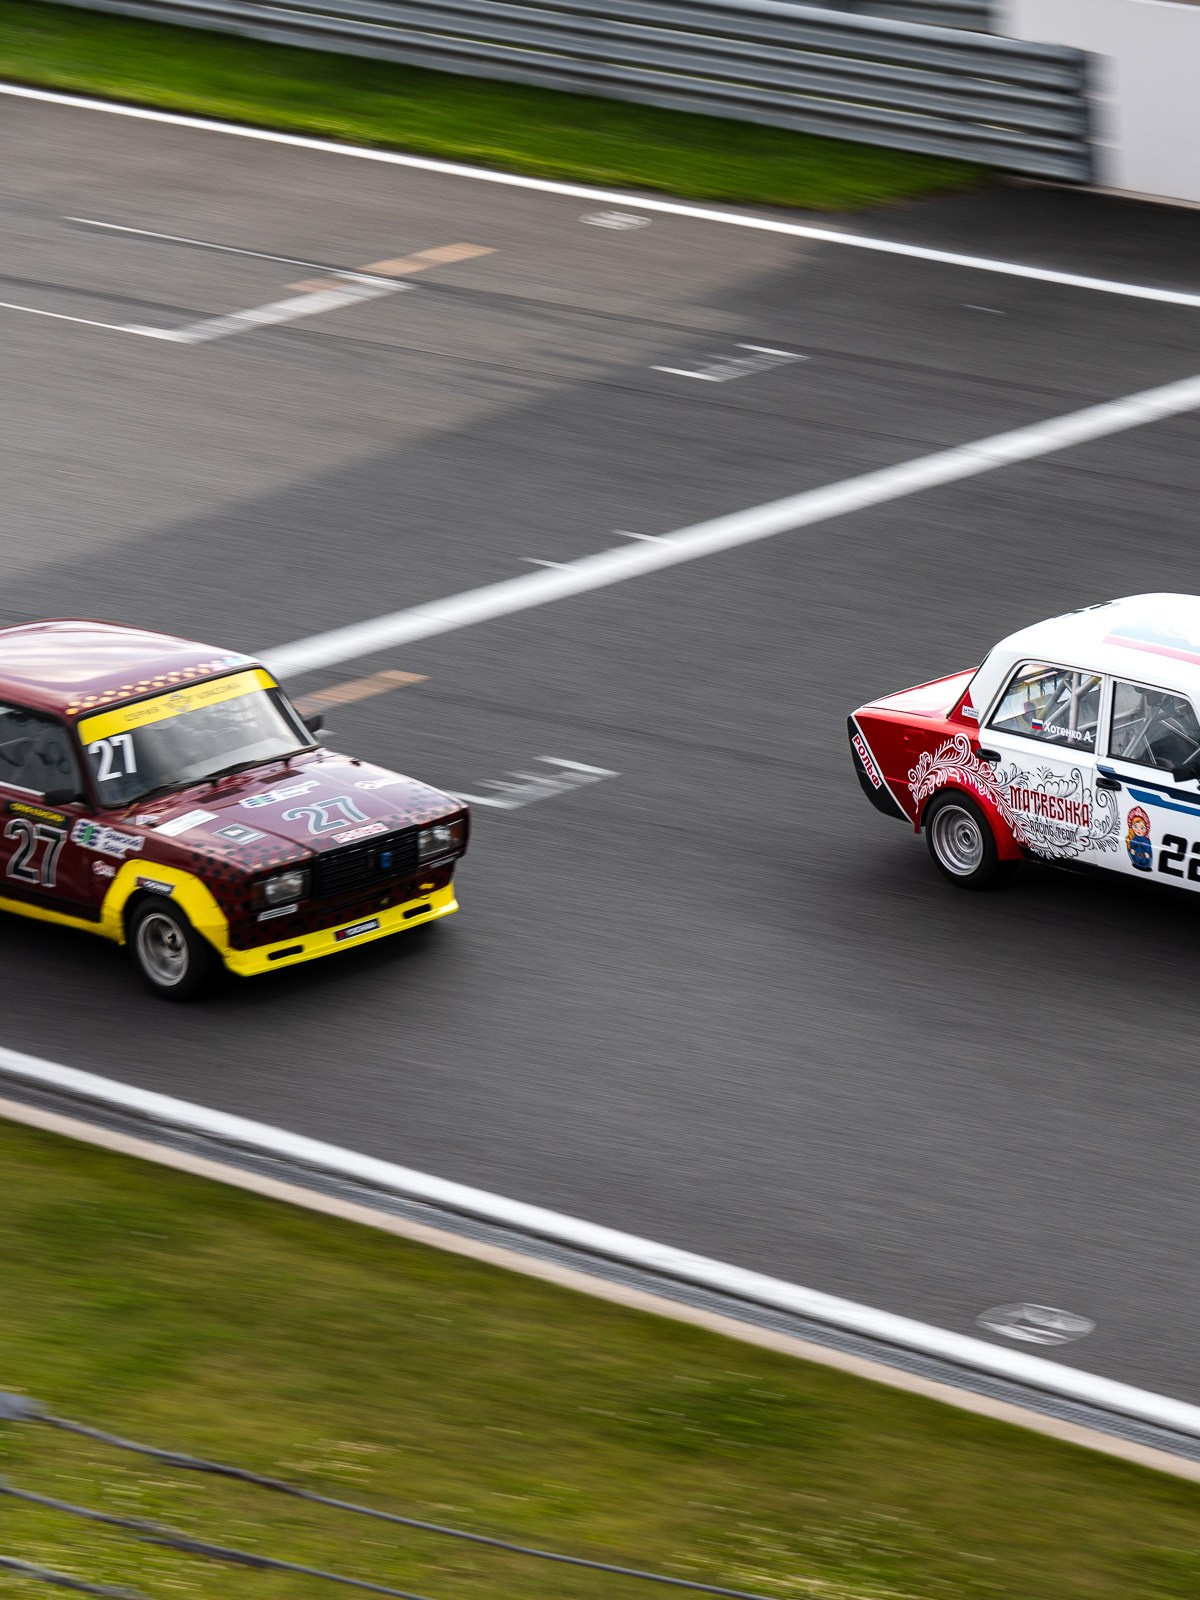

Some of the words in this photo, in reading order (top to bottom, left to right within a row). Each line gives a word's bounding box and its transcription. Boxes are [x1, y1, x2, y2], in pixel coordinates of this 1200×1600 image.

[1043, 721, 1082, 740] Хотенко
[87, 733, 137, 782] 27
[853, 734, 881, 787] РОЛЬФ
[281, 795, 371, 835] 27
[1009, 785, 1090, 828] MATRESHKA
[1030, 820, 1053, 836] RACING
[4, 818, 68, 888] 27
